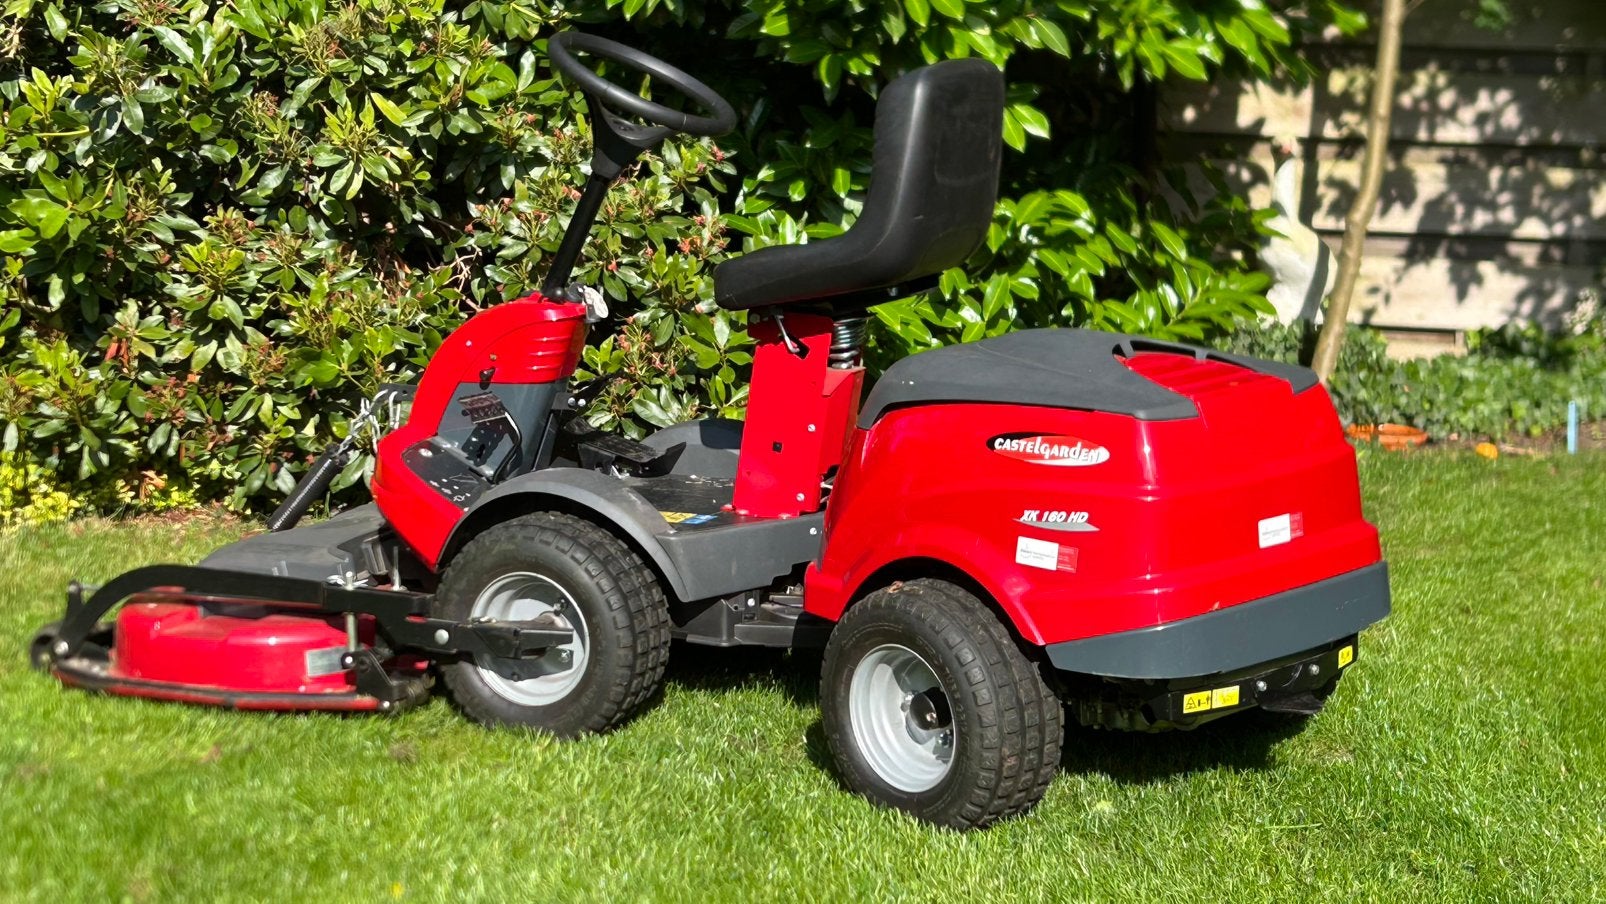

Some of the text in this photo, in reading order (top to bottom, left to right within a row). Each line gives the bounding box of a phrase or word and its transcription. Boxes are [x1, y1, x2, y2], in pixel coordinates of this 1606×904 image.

[1020, 509, 1089, 524] XK 160 HD
